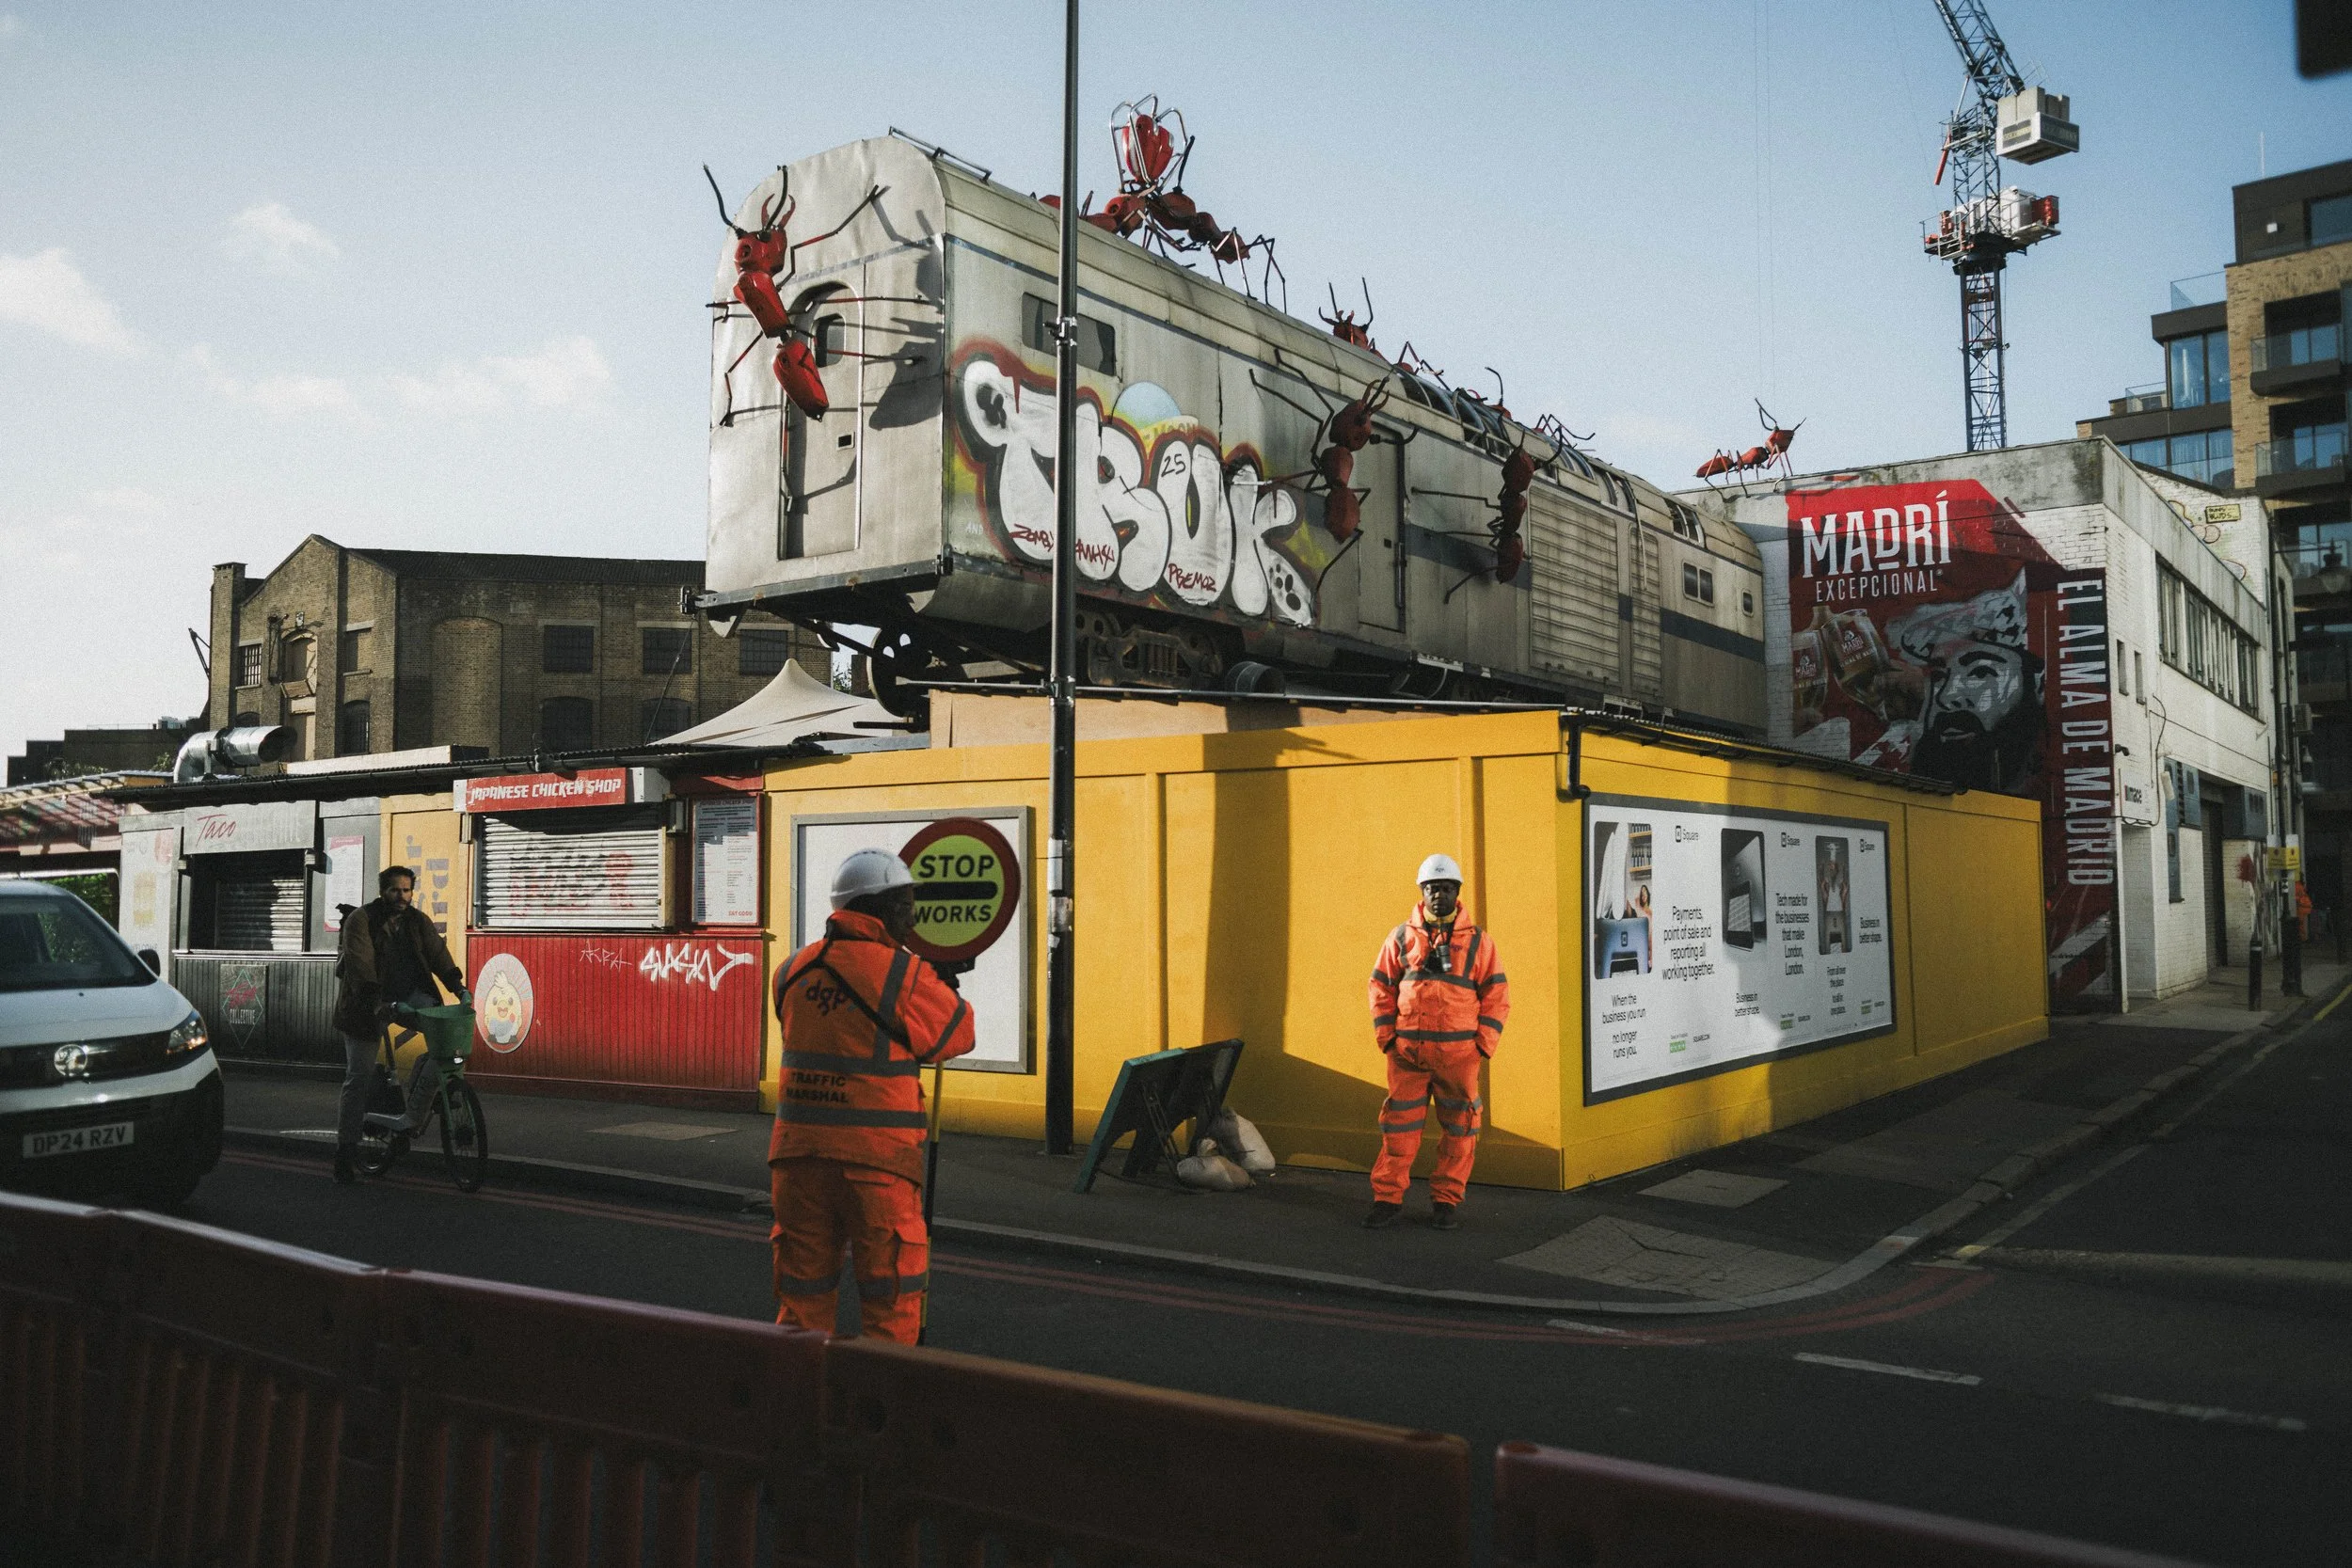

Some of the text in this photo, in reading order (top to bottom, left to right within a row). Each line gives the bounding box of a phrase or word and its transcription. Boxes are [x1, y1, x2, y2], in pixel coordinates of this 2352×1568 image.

[1161, 453, 1185, 477] 25
[1800, 489, 1951, 578] MADRÍ
[1816, 569, 1938, 603] EXCEPCIONAL
[2057, 578, 2114, 886] EL ALMA DE MADRID
[469, 778, 622, 805] JAPANESE CHICKEN SHOP
[196, 814, 237, 847] Taco
[917, 854, 994, 879] STOP
[1775, 893, 1788, 907] Tech
[914, 904, 993, 924] WORKS
[1775, 911, 1809, 924] the businesses
[1663, 926, 1680, 944] point
[1688, 924, 1699, 939] sale
[1700, 924, 1712, 939] and
[1671, 943, 1698, 961] reporting
[1661, 963, 1688, 982] working
[1611, 993, 1637, 1007] When the
[1601, 1007, 1646, 1024] business you run
[1612, 1031, 1637, 1044] no longer
[1613, 1047, 1626, 1058] runs
[791, 1070, 847, 1087] TRAFFIC
[787, 1086, 849, 1103] MARSHAL
[33, 1126, 126, 1154] DP24 RZV
